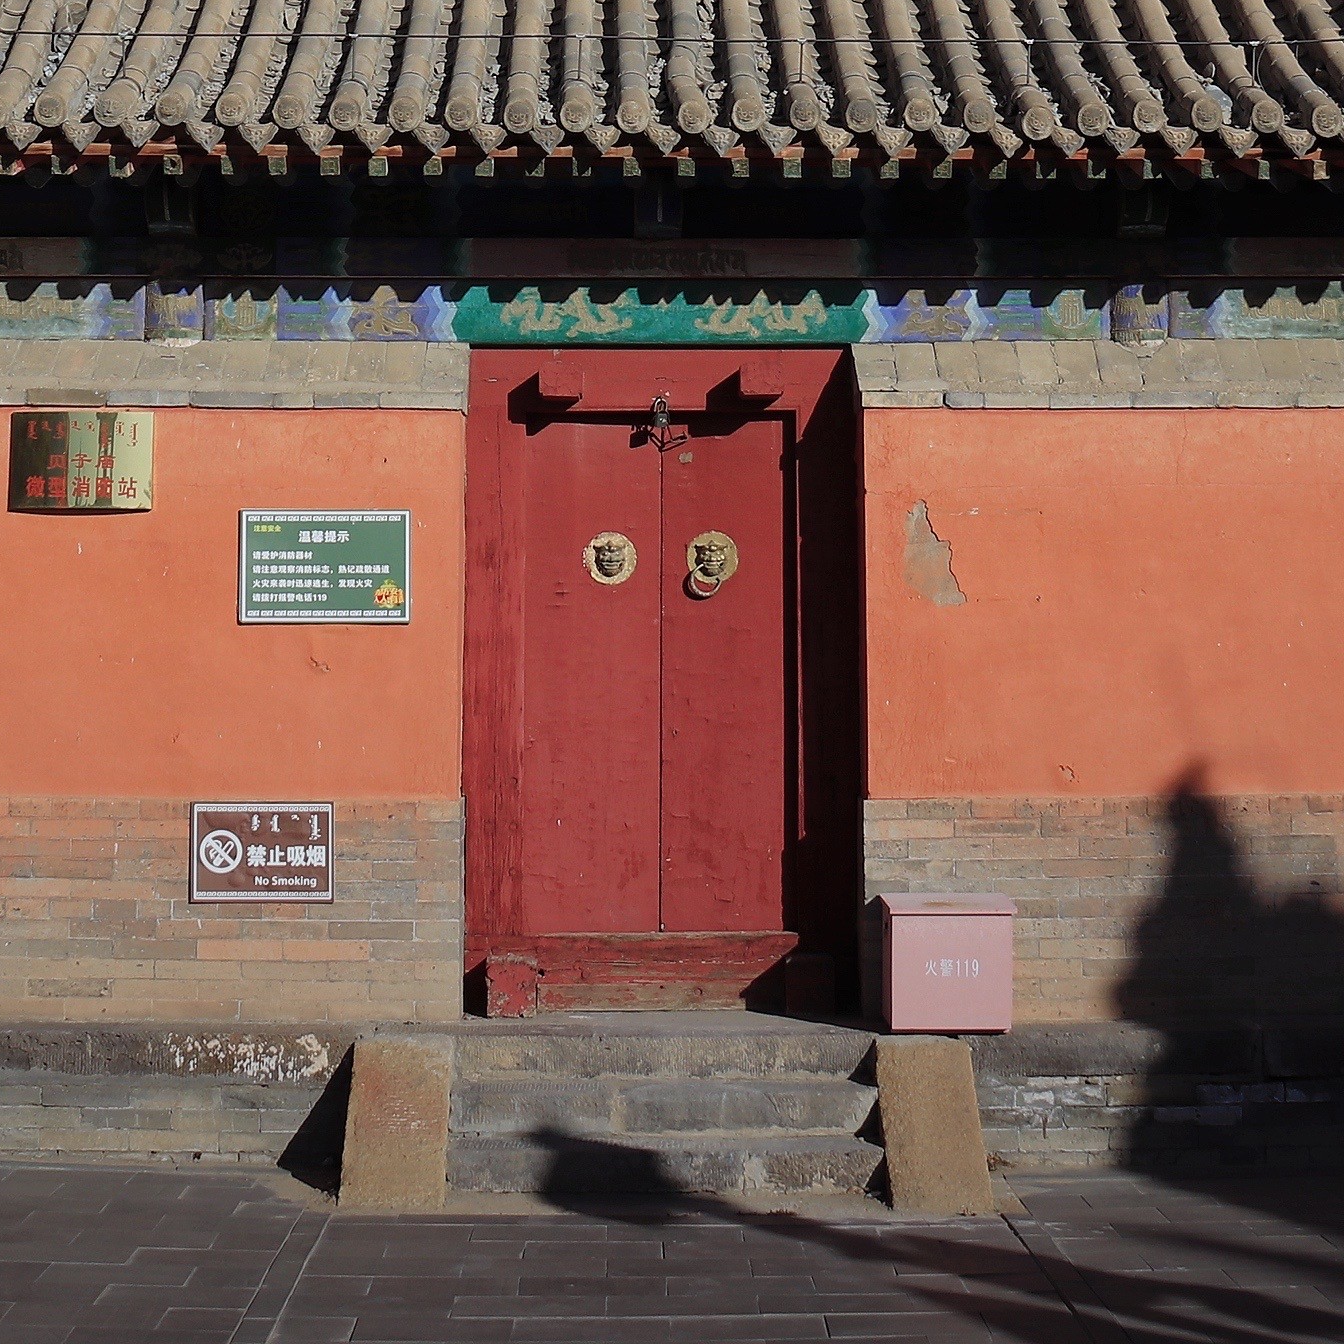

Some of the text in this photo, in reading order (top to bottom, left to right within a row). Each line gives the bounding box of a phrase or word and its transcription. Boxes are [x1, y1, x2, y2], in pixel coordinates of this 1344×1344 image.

[47, 453, 116, 470] 贝子庙
[26, 475, 138, 499] 微型消防站
[298, 530, 350, 543] 温馨提示
[252, 550, 313, 560] 请爱护消防器材
[252, 592, 328, 602] 请拨打报警电话119
[246, 844, 326, 868] 禁止吸烟
[254, 875, 317, 888] No Smoking
[924, 958, 980, 978] 火警119
